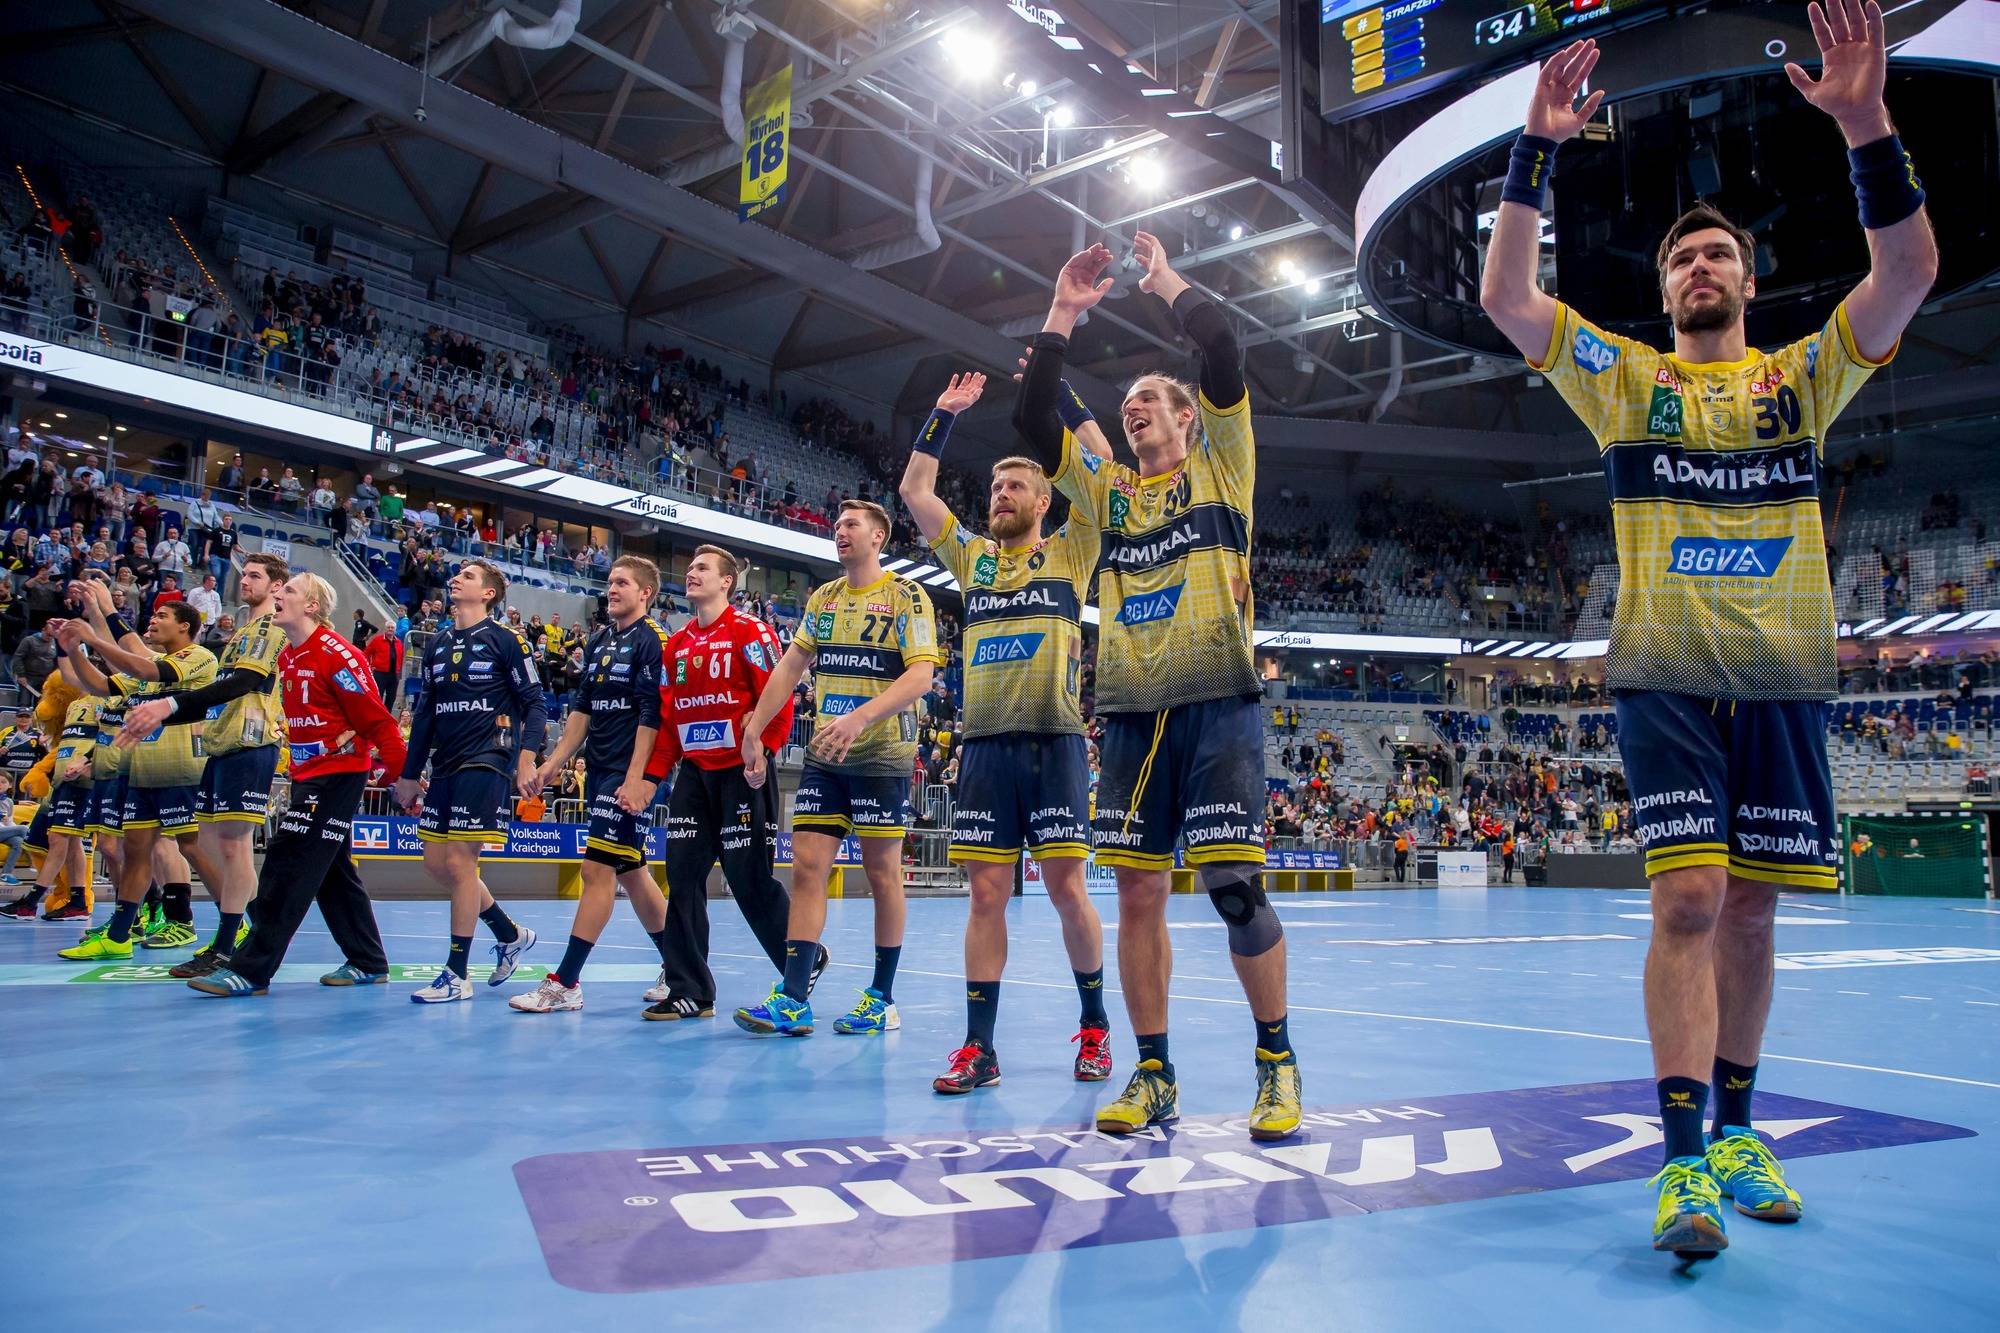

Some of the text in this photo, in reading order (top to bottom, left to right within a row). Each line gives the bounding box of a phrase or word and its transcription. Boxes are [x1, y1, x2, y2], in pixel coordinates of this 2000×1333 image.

[1488, 11, 1523, 44] 34
[750, 111, 785, 142] Myrhol
[746, 131, 785, 182] 18
[1574, 334, 1614, 371] SAP
[1752, 385, 1801, 439] 30
[1651, 415, 1681, 433] Ban
[1653, 454, 1814, 490] ADMIRAL
[630, 497, 677, 518] afri cola
[860, 614, 894, 643] 27
[710, 641, 732, 650] REWE
[189, 659, 213, 675] ADMIR
[709, 653, 732, 678] 61
[335, 671, 358, 691] SAP
[301, 680, 309, 703] 1
[435, 698, 494, 715] DMIRAL
[288, 714, 327, 727] MIRAL
[851, 799, 880, 807] MIRAL
[1185, 802, 1247, 821] ADMIRAL
[287, 811, 313, 822] MIRAL
[327, 818, 351, 829] ADMIR
[956, 811, 995, 821] MIRAL
[1096, 808, 1144, 823] DMIRAL
[1736, 804, 1817, 825] ADMIRAL
[511, 829, 561, 840] Volksbank
[1201, 822, 1248, 840] DURAVIT
[1650, 813, 1715, 840] DURAVIT
[398, 840, 424, 850] Kraic
[511, 843, 560, 855] Kraichgau
[1763, 832, 1819, 856] DURAVIT
